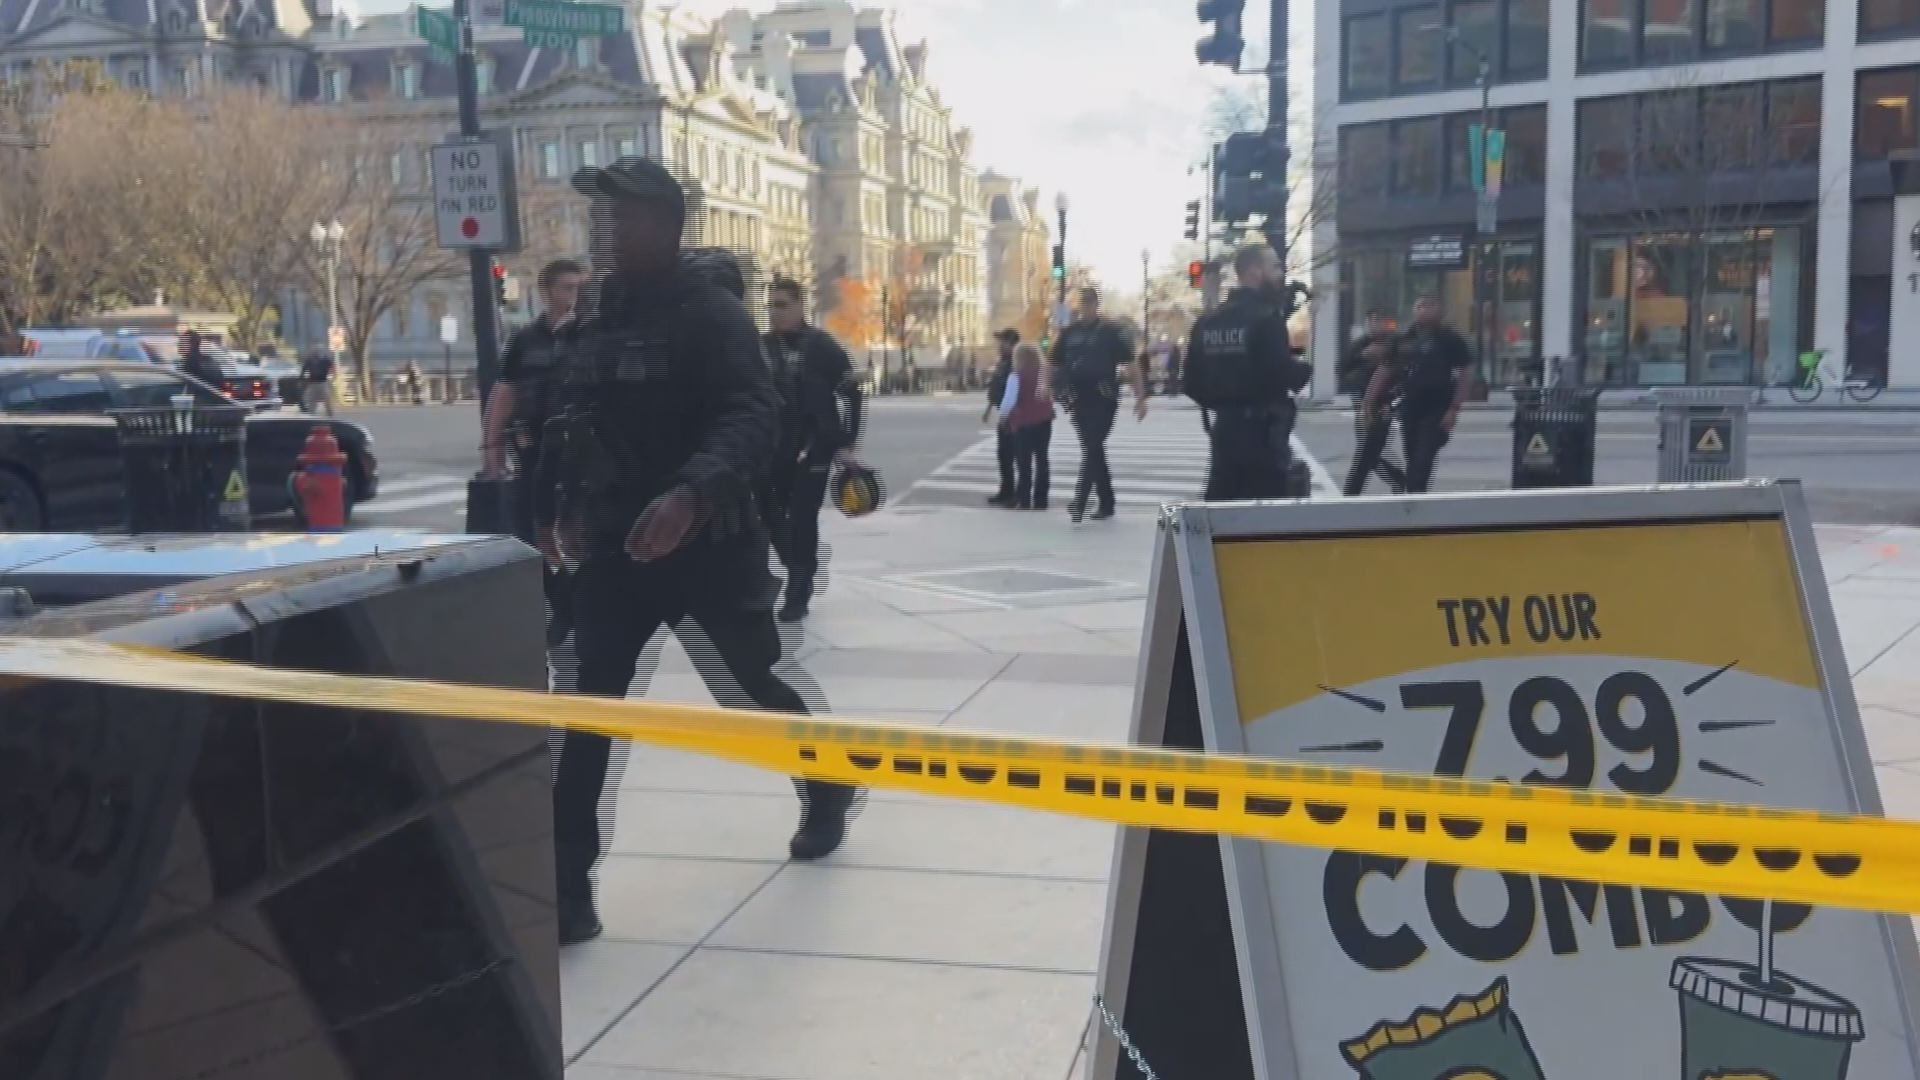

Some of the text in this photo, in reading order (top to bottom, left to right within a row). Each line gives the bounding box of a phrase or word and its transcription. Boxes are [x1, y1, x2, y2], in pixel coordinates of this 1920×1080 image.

[508, 2, 601, 31] Pennsylvania
[527, 31, 573, 49] 1700
[450, 150, 480, 171] NO
[448, 174, 487, 193] TURN
[468, 194, 497, 213] RED
[1202, 327, 1246, 345] POLICE
[1437, 592, 1602, 647] TRY OUR
